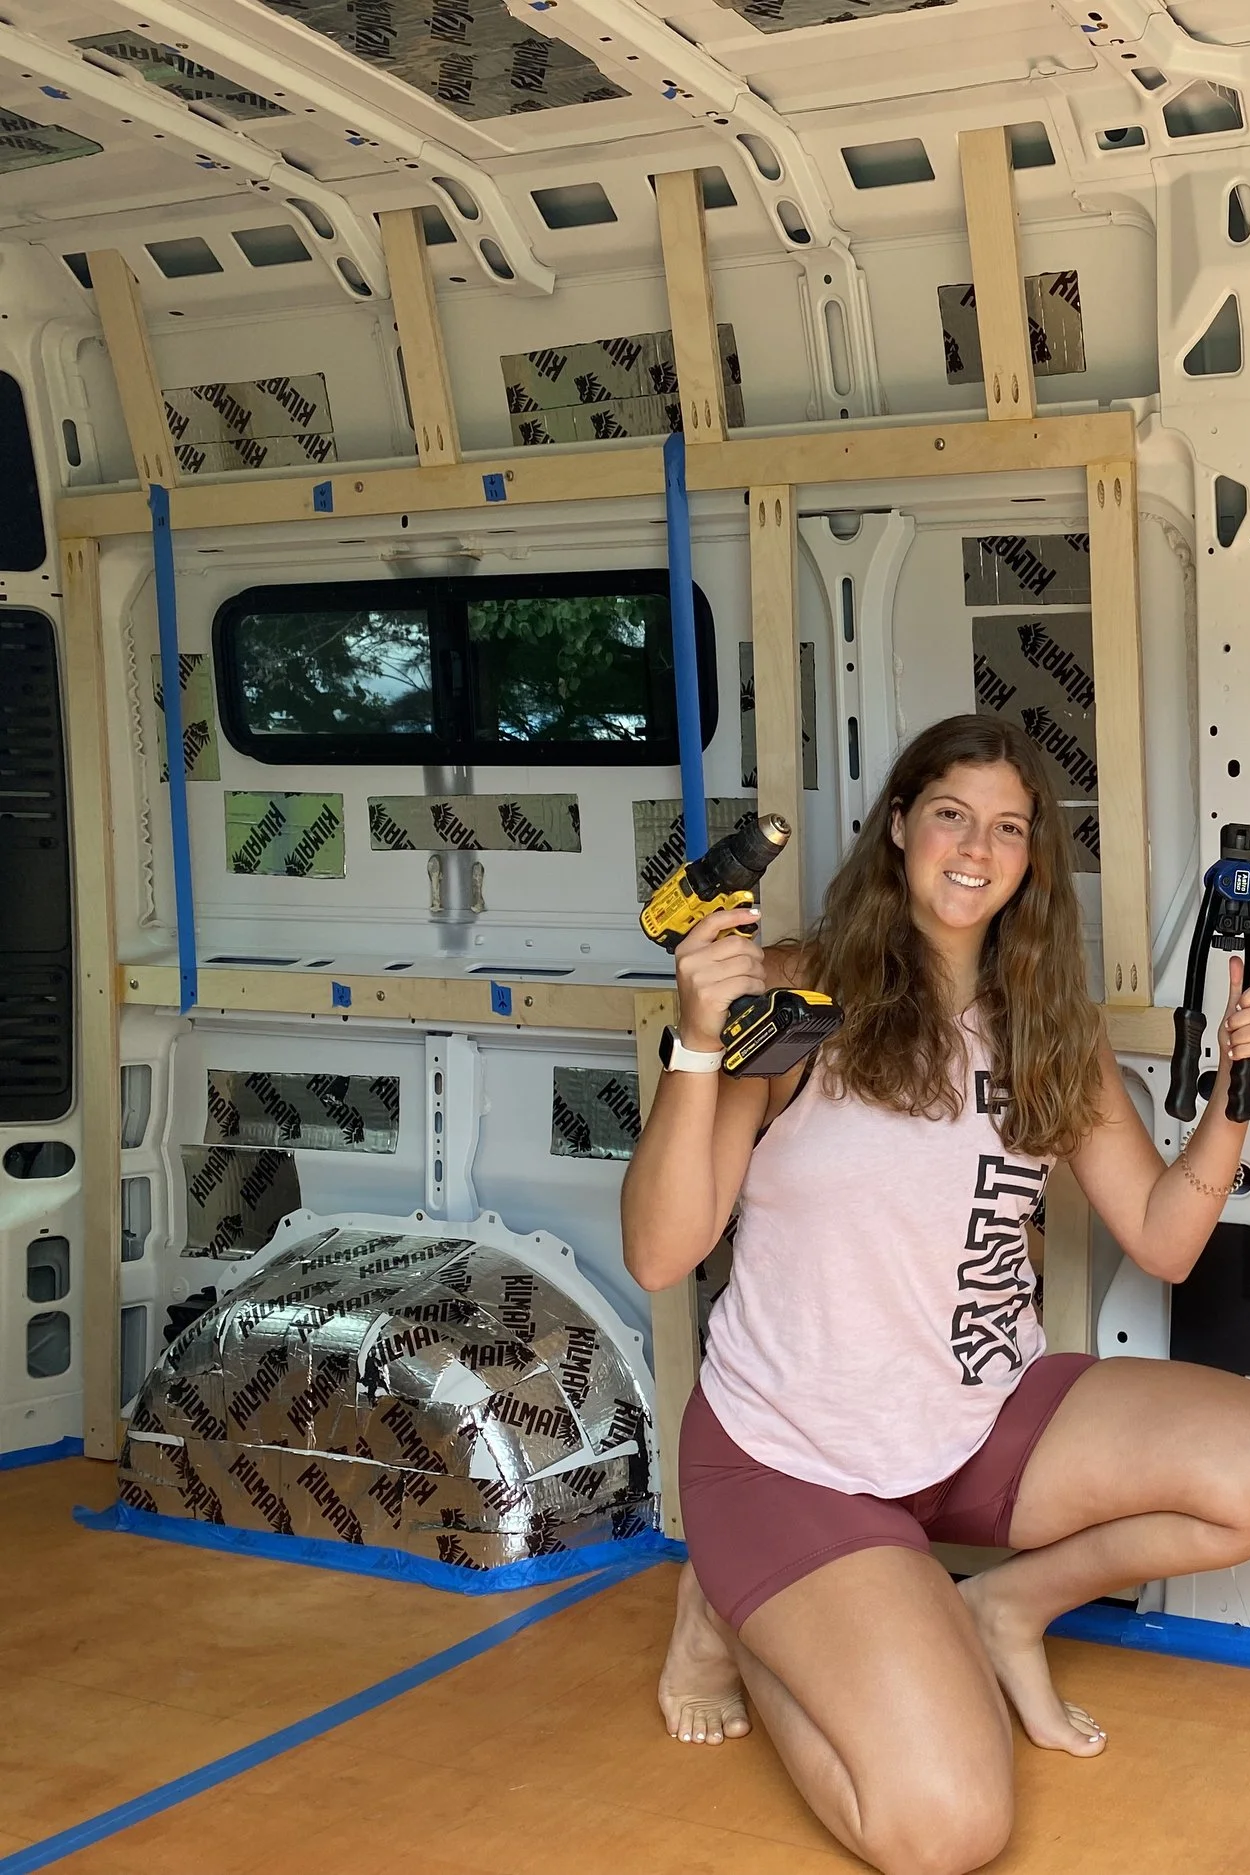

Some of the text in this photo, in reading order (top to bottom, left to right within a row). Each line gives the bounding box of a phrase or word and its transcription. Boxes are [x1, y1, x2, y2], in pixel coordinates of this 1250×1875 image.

[164, 400, 190, 441] KIL
[597, 1077, 642, 1143] KILMA
[951, 1070, 1049, 1386] INK
[460, 1340, 509, 1370] MAT
